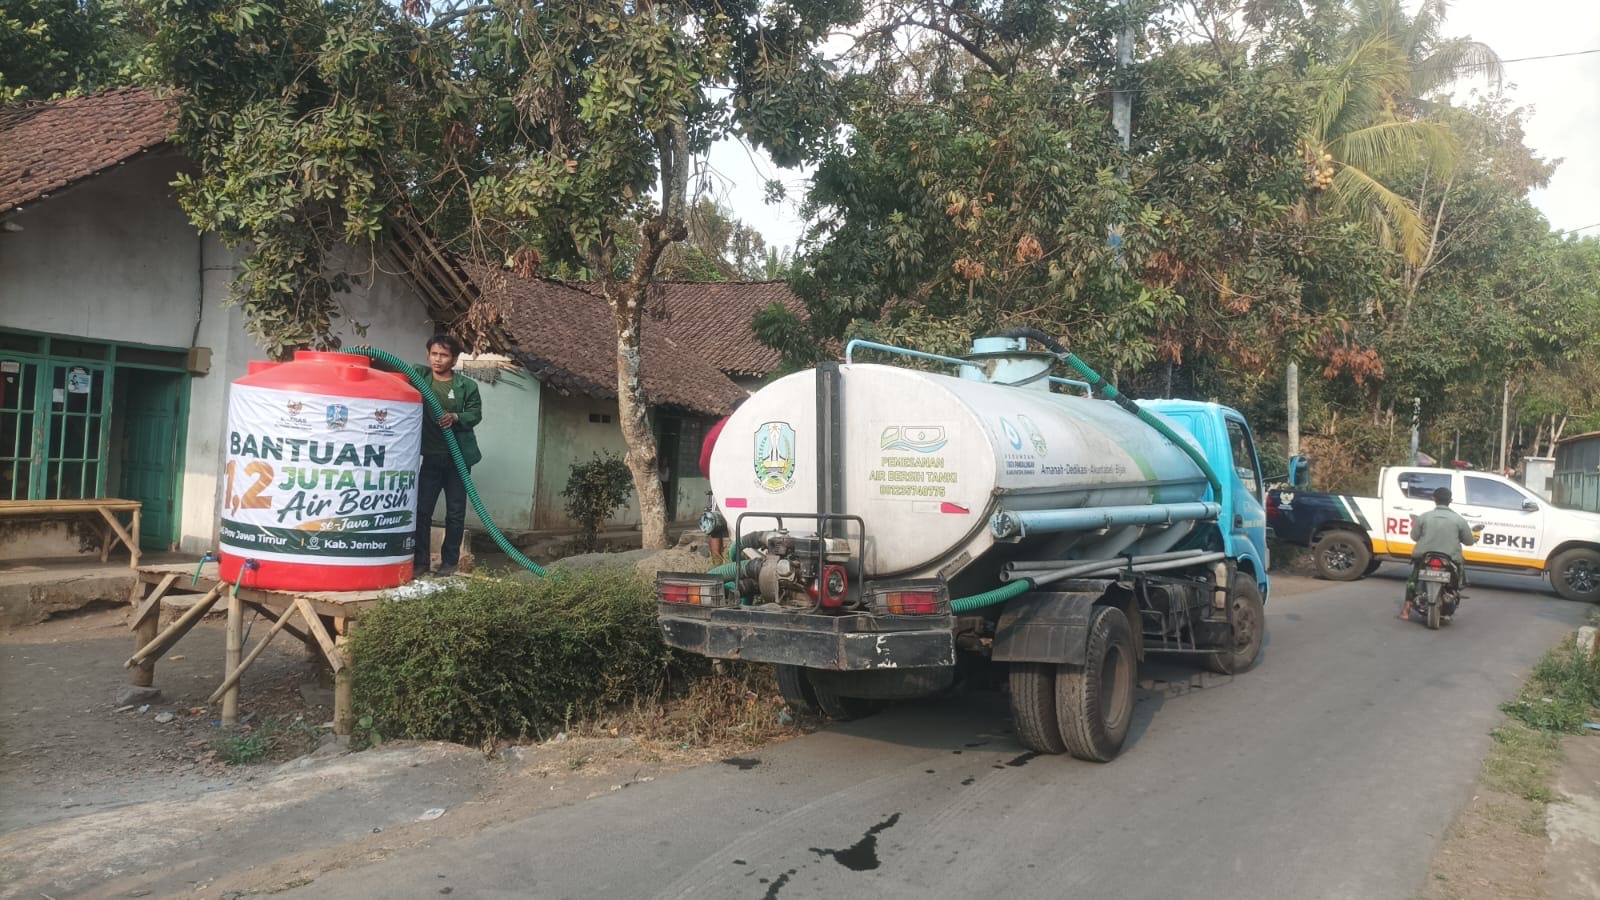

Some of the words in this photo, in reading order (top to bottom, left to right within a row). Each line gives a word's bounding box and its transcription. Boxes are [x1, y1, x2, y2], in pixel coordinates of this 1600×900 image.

[230, 431, 386, 468] BANTUAN
[881, 456, 945, 468] PEMESANAN
[278, 466, 356, 491] JUTA
[363, 469, 417, 491] LITER
[869, 470, 886, 481] AIR
[887, 471, 925, 482] BERSIH
[926, 472, 958, 483] TANKI
[225, 460, 274, 517] 1,2
[277, 490, 331, 524] Air
[335, 486, 410, 516] Bersih
[374, 513, 404, 528] Timur
[236, 530, 256, 542] Jawa
[257, 533, 288, 546] Timur
[324, 539, 349, 550] Kab.
[350, 540, 388, 550] Jember
[1483, 533, 1535, 549] BPKH
